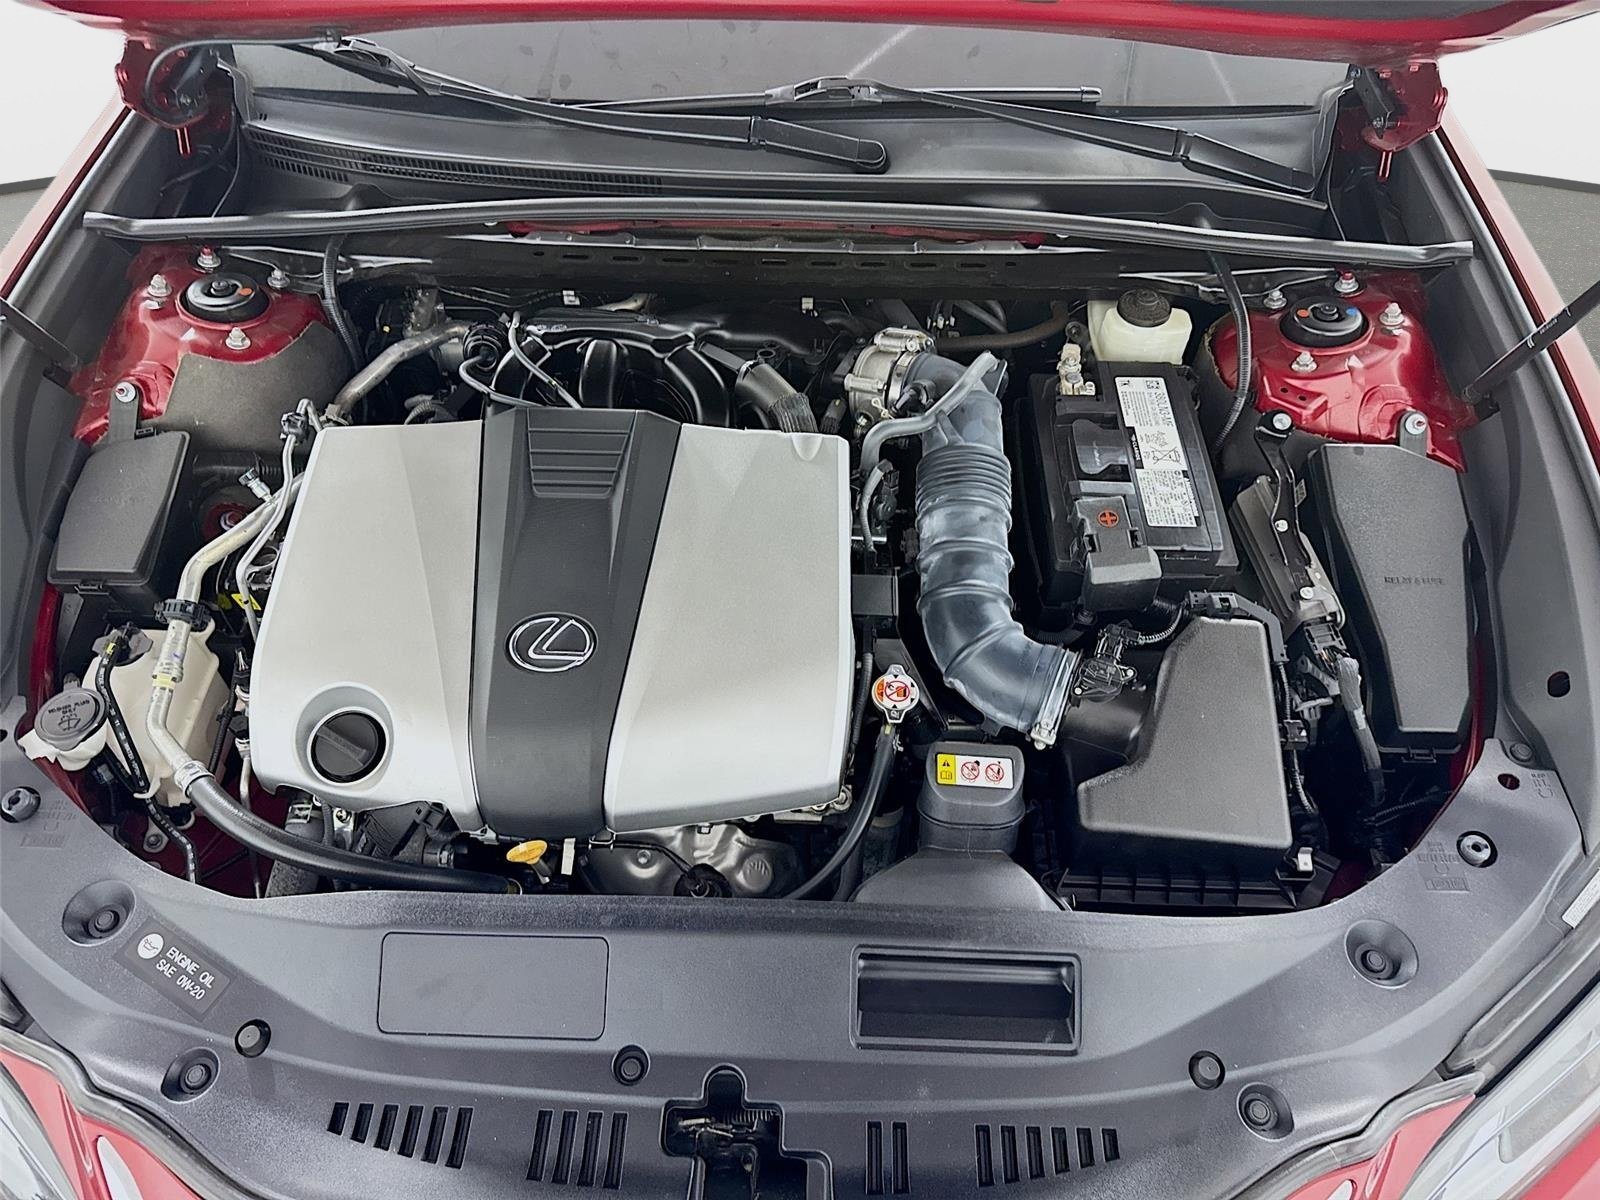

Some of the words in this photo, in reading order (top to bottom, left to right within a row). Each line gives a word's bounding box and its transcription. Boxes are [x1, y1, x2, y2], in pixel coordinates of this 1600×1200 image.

[156, 959, 177, 978] SAE
[176, 974, 206, 1000] 0W-20
[166, 946, 200, 975] ENGINE
[199, 971, 215, 989] OIL
